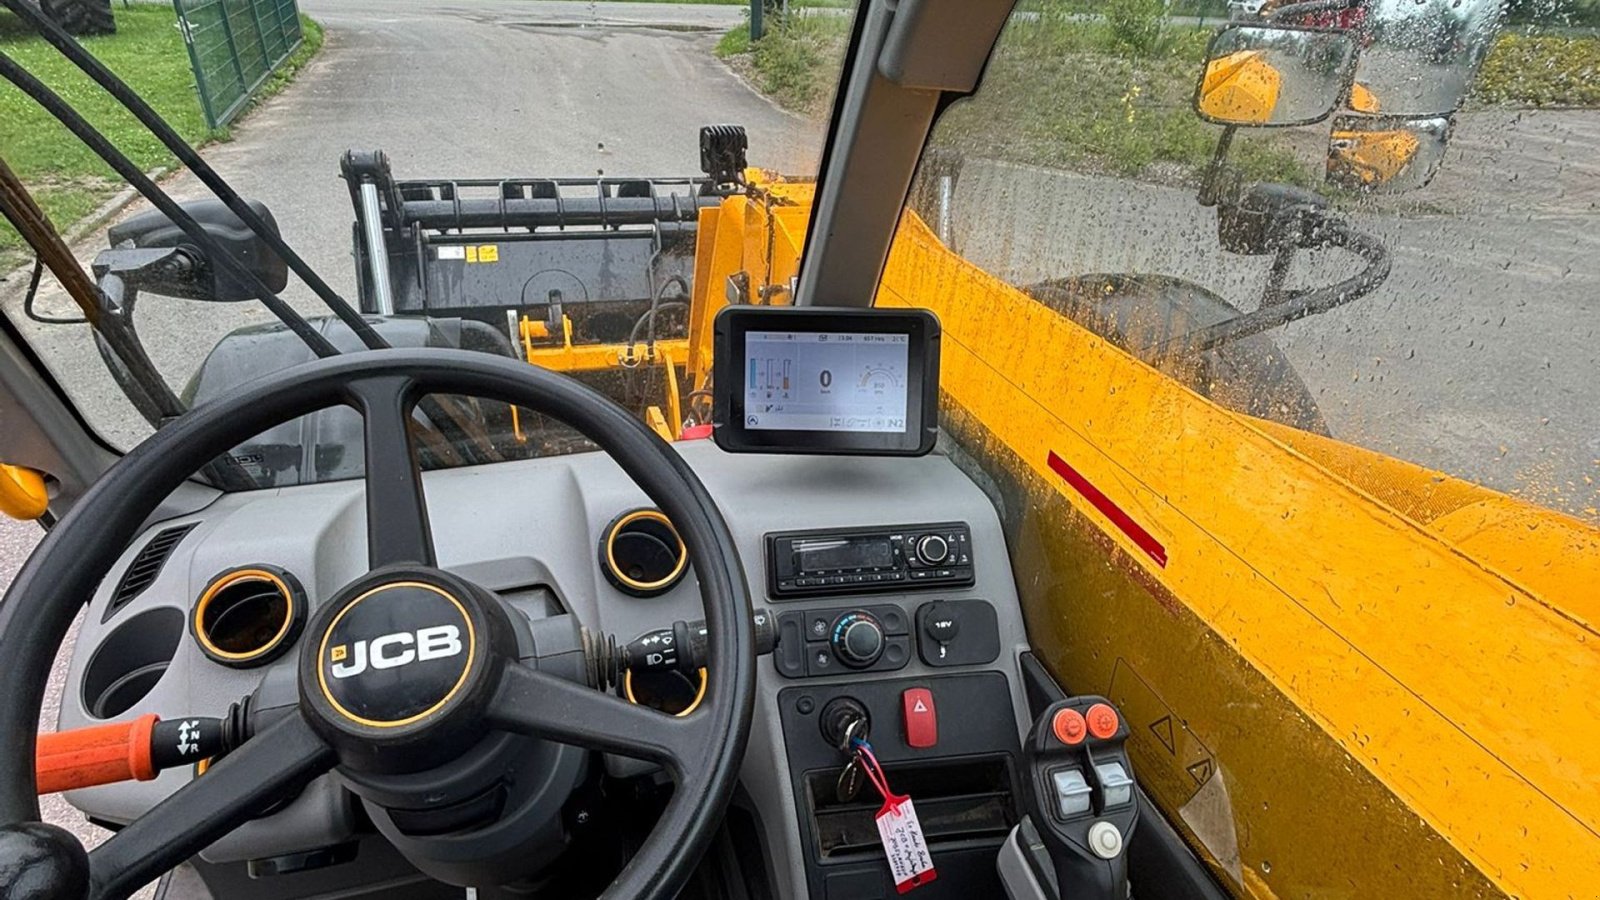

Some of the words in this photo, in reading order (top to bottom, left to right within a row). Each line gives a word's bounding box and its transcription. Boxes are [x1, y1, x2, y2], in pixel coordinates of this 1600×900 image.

[819, 370, 832, 388] 0
[331, 624, 462, 678] JCB
[190, 730, 200, 740] N
[190, 743, 199, 753] R
